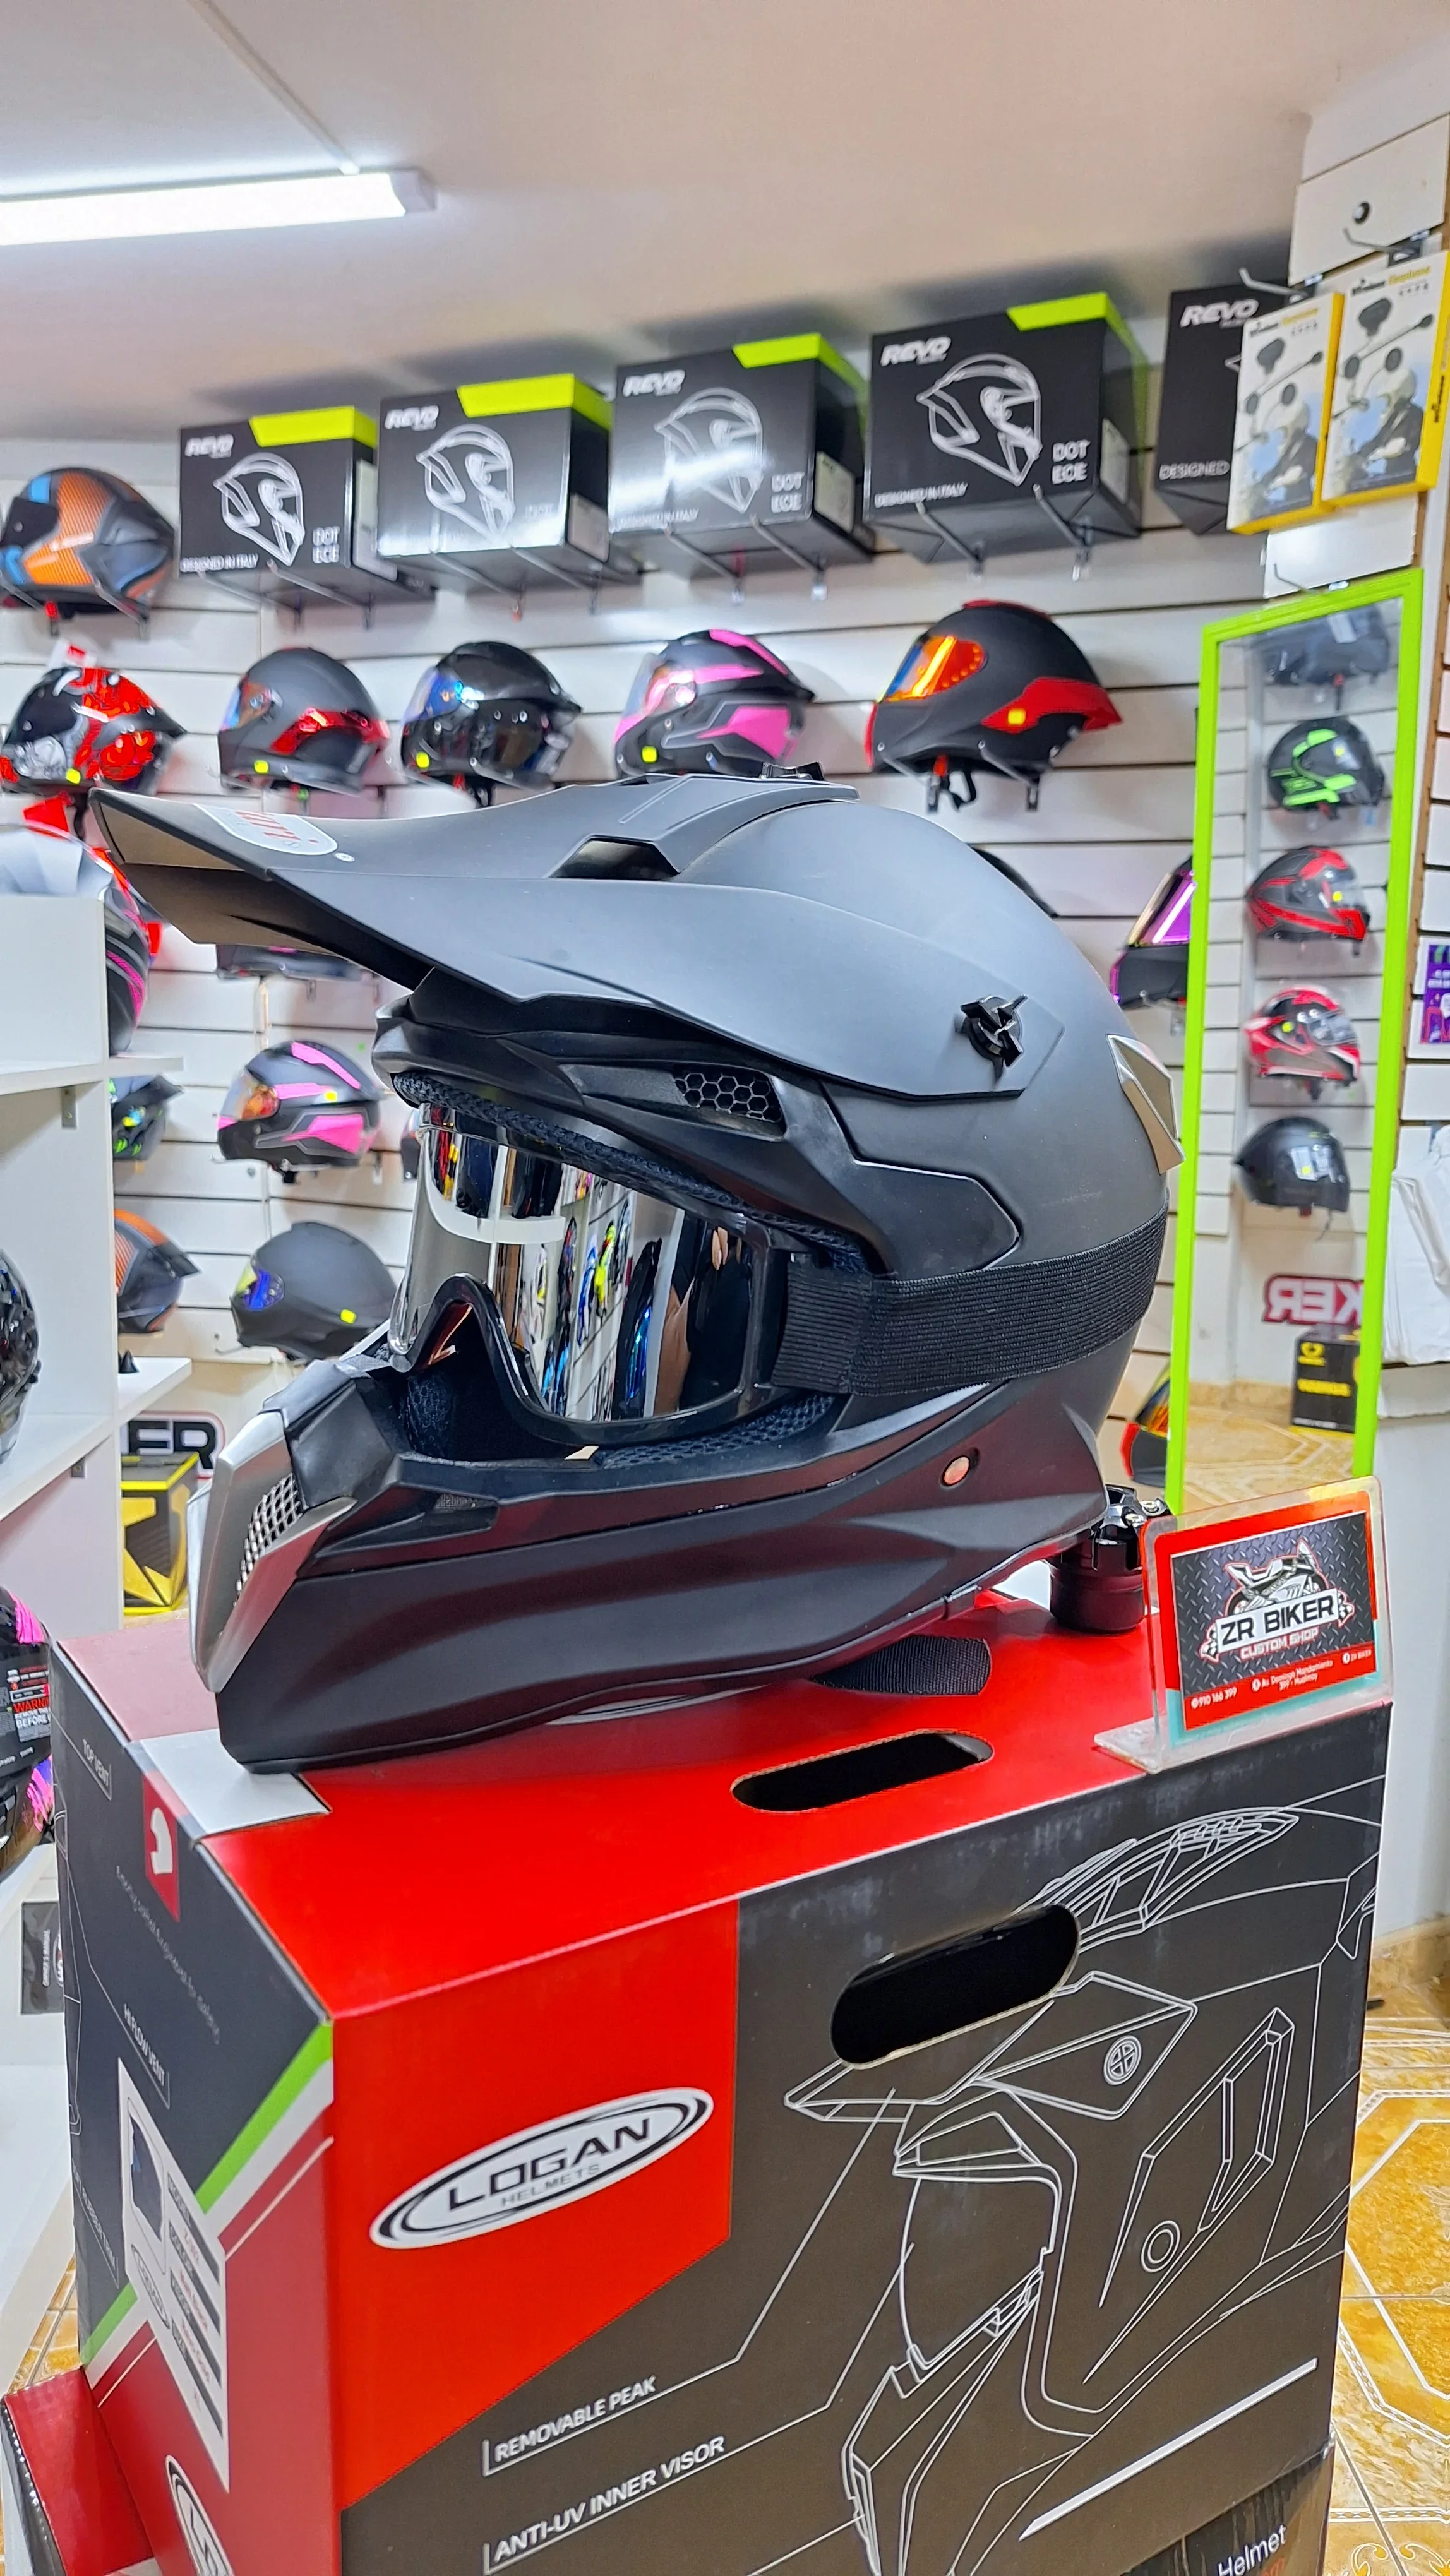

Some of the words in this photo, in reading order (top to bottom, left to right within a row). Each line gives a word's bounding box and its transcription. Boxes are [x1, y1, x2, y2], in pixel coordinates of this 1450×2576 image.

[1180, 299, 1259, 328] REVO
[880, 337, 951, 366] REVO
[1053, 439, 1090, 462] DOT
[1159, 460, 1230, 480] DESIGNED
[772, 472, 805, 492] DOT
[128, 1421, 217, 1469] ER
[1221, 1617, 1254, 1645] ZR
[1264, 1595, 1334, 1634] BIKER
[1240, 1635, 1287, 1660] CUSTOM
[1289, 1627, 1319, 1645] SHOP
[13, 1698, 49, 1714] WARNI
[1199, 1694, 1211, 1707] 910
[1225, 1686, 1237, 1700] 399
[83, 1739, 94, 1763] TOP
[95, 1755, 109, 1787] VENT
[131, 2015, 148, 2056] FLOW
[148, 2046, 165, 2087] VENT
[449, 2118, 650, 2211] LOGAN
[501, 2164, 601, 2206] HELMETS
[495, 2398, 606, 2462] REMOVABLE
[608, 2375, 656, 2411] PEAK
[494, 2501, 586, 2562] ANTI-UV
[589, 2469, 657, 2515] INNER
[660, 2435, 725, 2479] VISOR
[1217, 2524, 1287, 2576] Helmet
